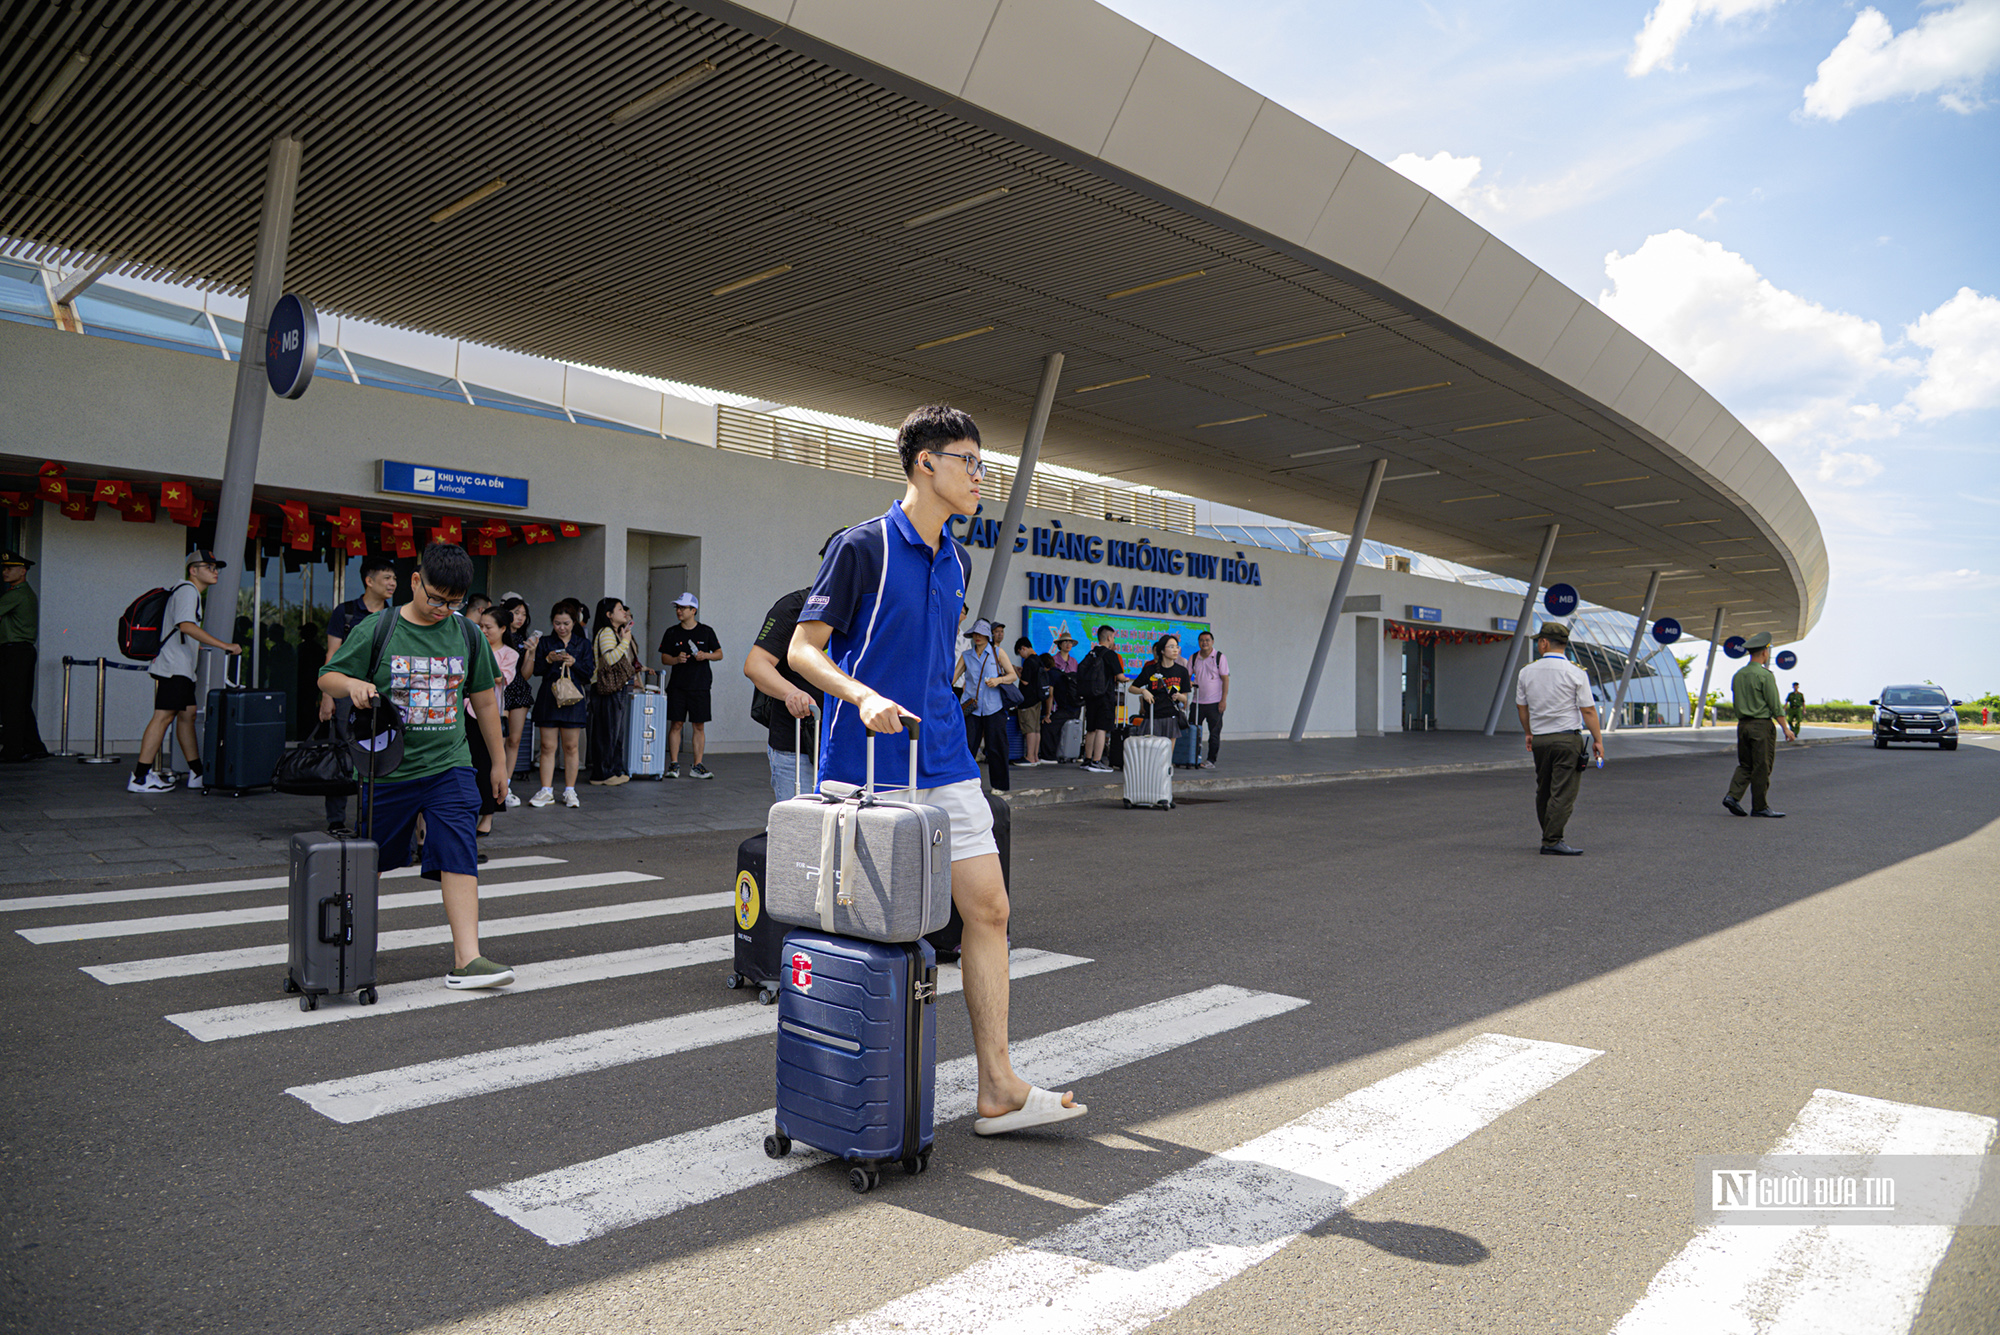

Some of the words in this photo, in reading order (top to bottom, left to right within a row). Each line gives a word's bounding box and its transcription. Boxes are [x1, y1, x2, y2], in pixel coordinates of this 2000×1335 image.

[281, 328, 300, 354] MB
[438, 472, 454, 482] KHU
[455, 474, 473, 486] VỰC
[474, 477, 488, 486] GA
[438, 484, 466, 494] Arrivals
[1032, 520, 1104, 563] HÀNG
[1107, 537, 1185, 576] KHÔNG
[1186, 551, 1220, 580] TUY
[1221, 551, 1262, 586] HÒA
[1026, 571, 1071, 604] TUY
[1073, 576, 1126, 609] HOA
[1127, 584, 1210, 618] AIRPORT
[1558, 595, 1574, 604] MB
[1664, 626, 1679, 635] MB
